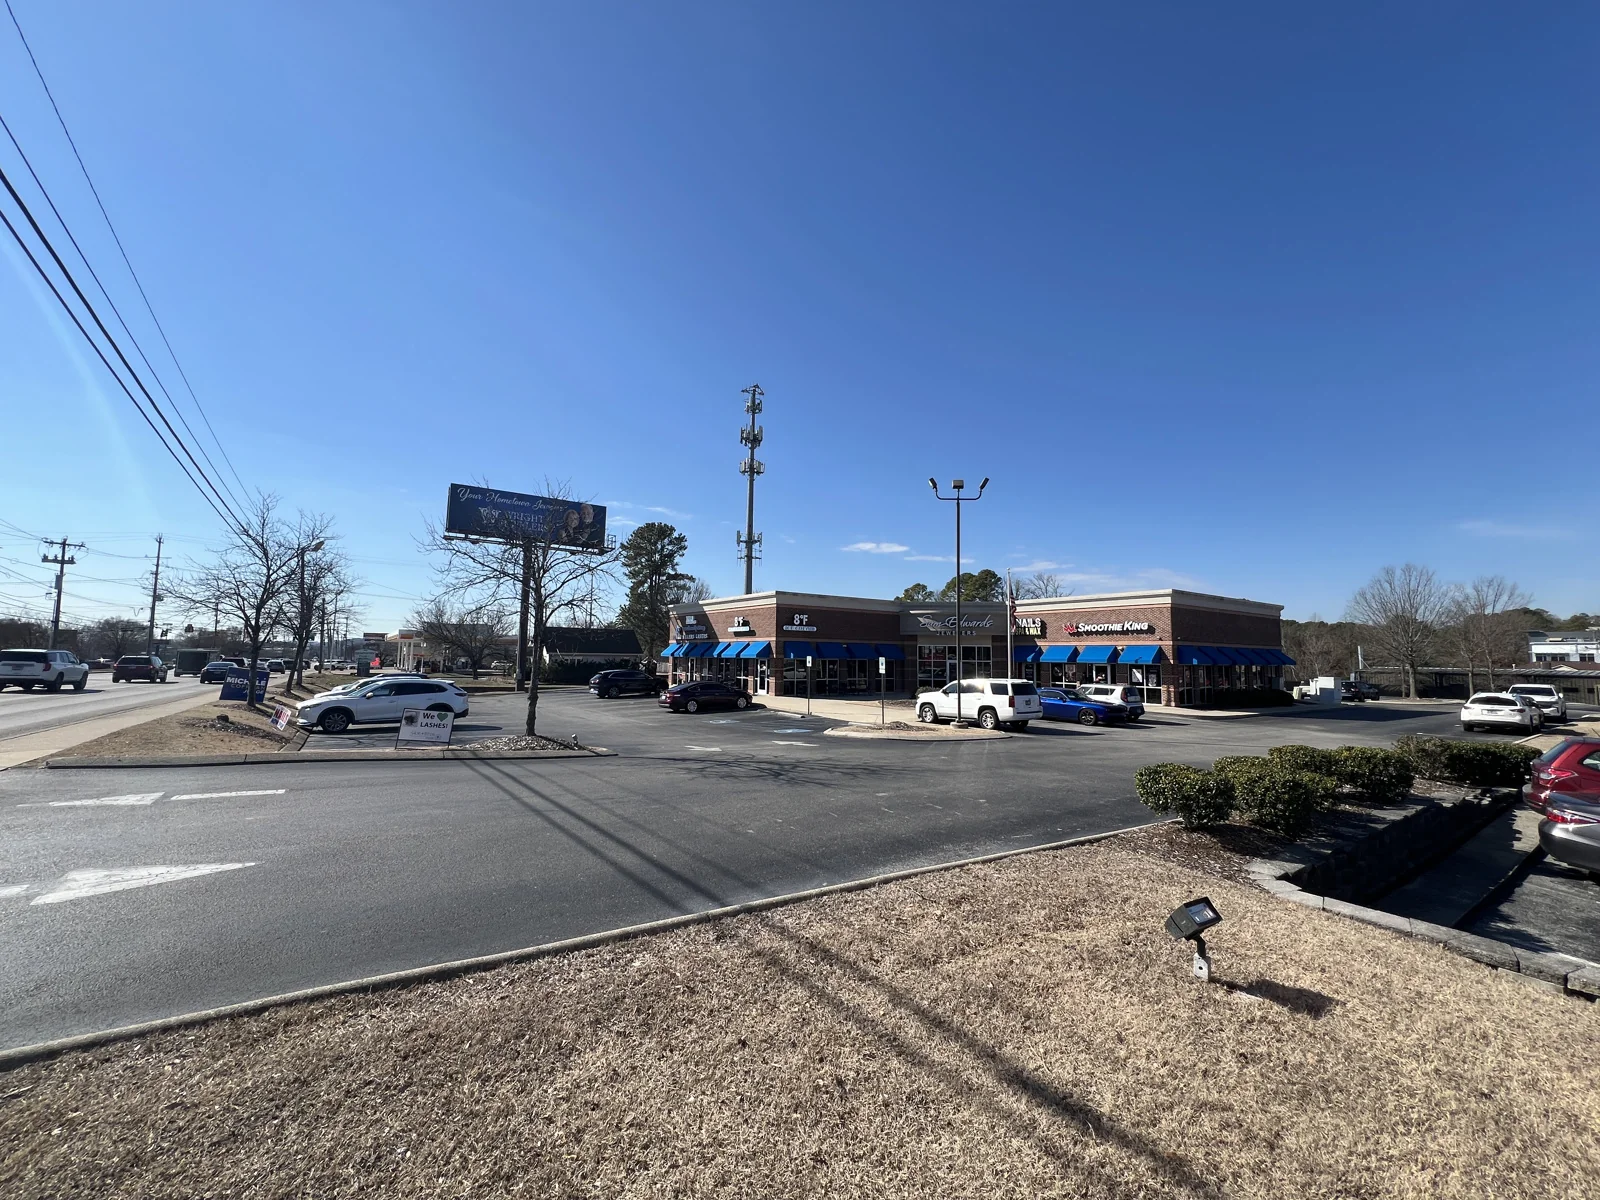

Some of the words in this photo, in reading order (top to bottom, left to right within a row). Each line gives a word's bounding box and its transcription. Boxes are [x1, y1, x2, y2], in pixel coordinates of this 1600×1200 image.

[457, 487, 483, 502] Your
[486, 491, 531, 508] Hometown
[919, 614, 943, 628] Sam
[1015, 617, 1041, 628] NAILS
[1077, 622, 1123, 632] SMOOTHIE
[1123, 620, 1149, 631] KING
[1029, 627, 1041, 636] WAX
[226, 676, 267, 686] MICHLE
[422, 712, 435, 720] We
[420, 721, 448, 729] LASHES!
